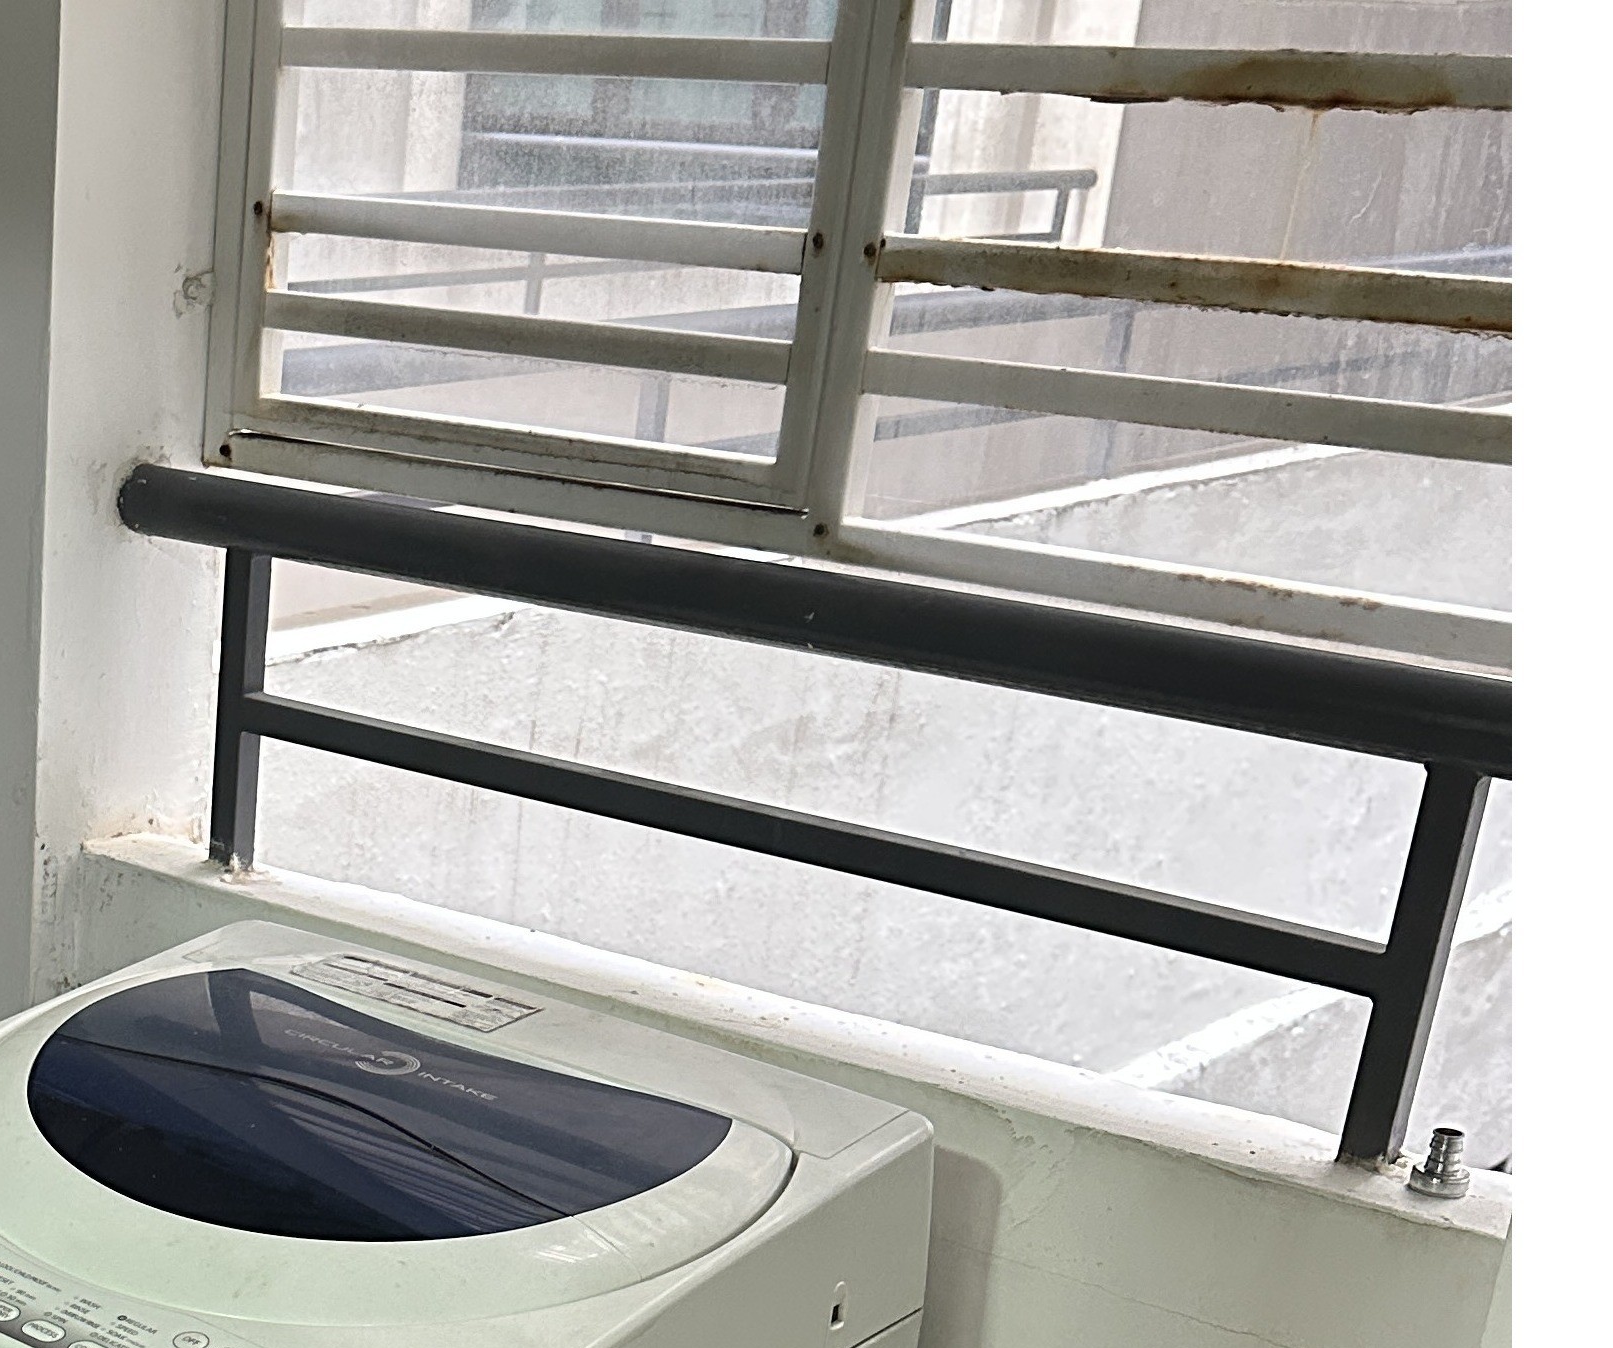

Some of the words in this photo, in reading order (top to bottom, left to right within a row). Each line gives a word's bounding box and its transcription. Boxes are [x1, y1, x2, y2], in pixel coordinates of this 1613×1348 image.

[285, 1029, 393, 1066] CIRCULAR
[418, 1071, 498, 1101] INTAKE
[182, 1335, 202, 1346] OFF
